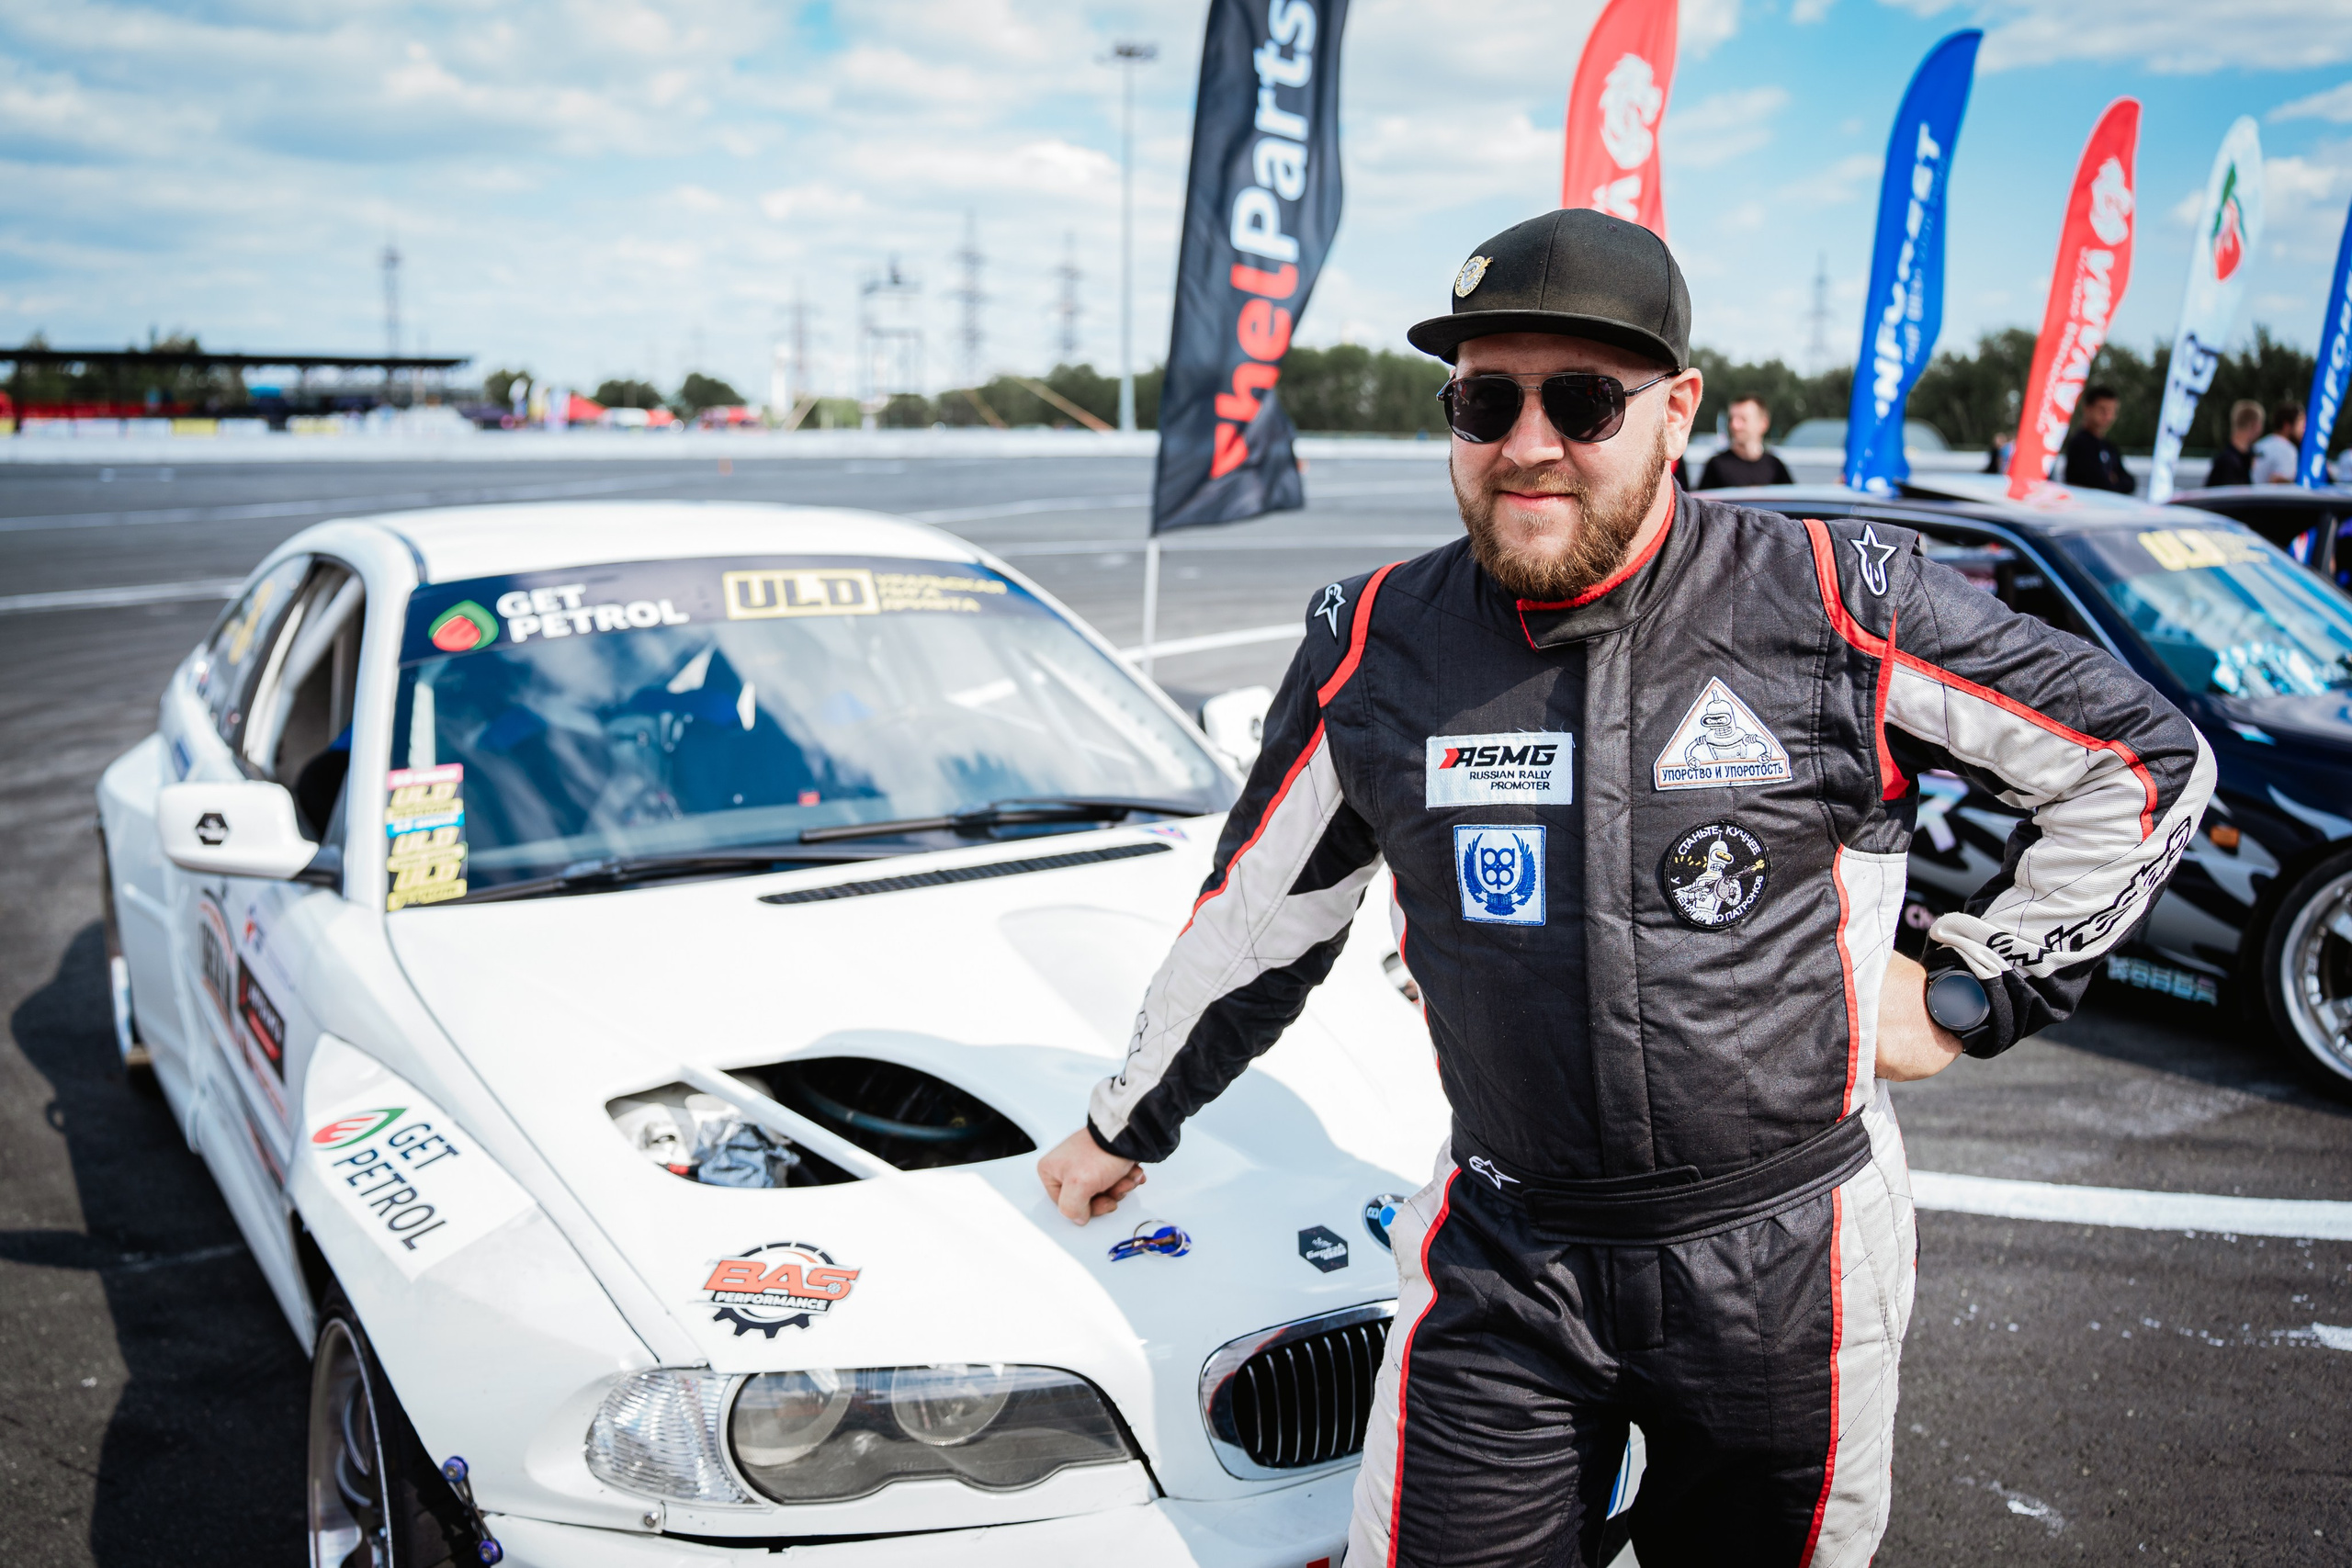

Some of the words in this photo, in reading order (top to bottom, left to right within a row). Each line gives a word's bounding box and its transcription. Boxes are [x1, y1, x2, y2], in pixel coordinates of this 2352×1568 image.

[496, 583, 586, 619] GET
[507, 599, 691, 643] PETROL
[1439, 745, 1558, 769] ASMG
[1662, 768, 1712, 782] УПОРСТВО
[1715, 766, 1722, 779] И
[1725, 762, 1783, 778] УПОРОТОСТЬ
[1469, 770, 1515, 780] RUSSIAN
[1519, 770, 1552, 780] RALLY
[1490, 781, 1551, 791] PROMOTER
[1678, 826, 1719, 856] СТАНЬТЕ
[1725, 826, 1762, 856] КУЧНЕЕ
[1670, 876, 1680, 885] У
[1725, 875, 1764, 922] ПАТРОНОВ
[388, 1122, 459, 1170] GET
[332, 1148, 447, 1251] PETROL
[703, 1259, 860, 1301] BAS
[714, 1291, 828, 1311] PERFORMANCE
